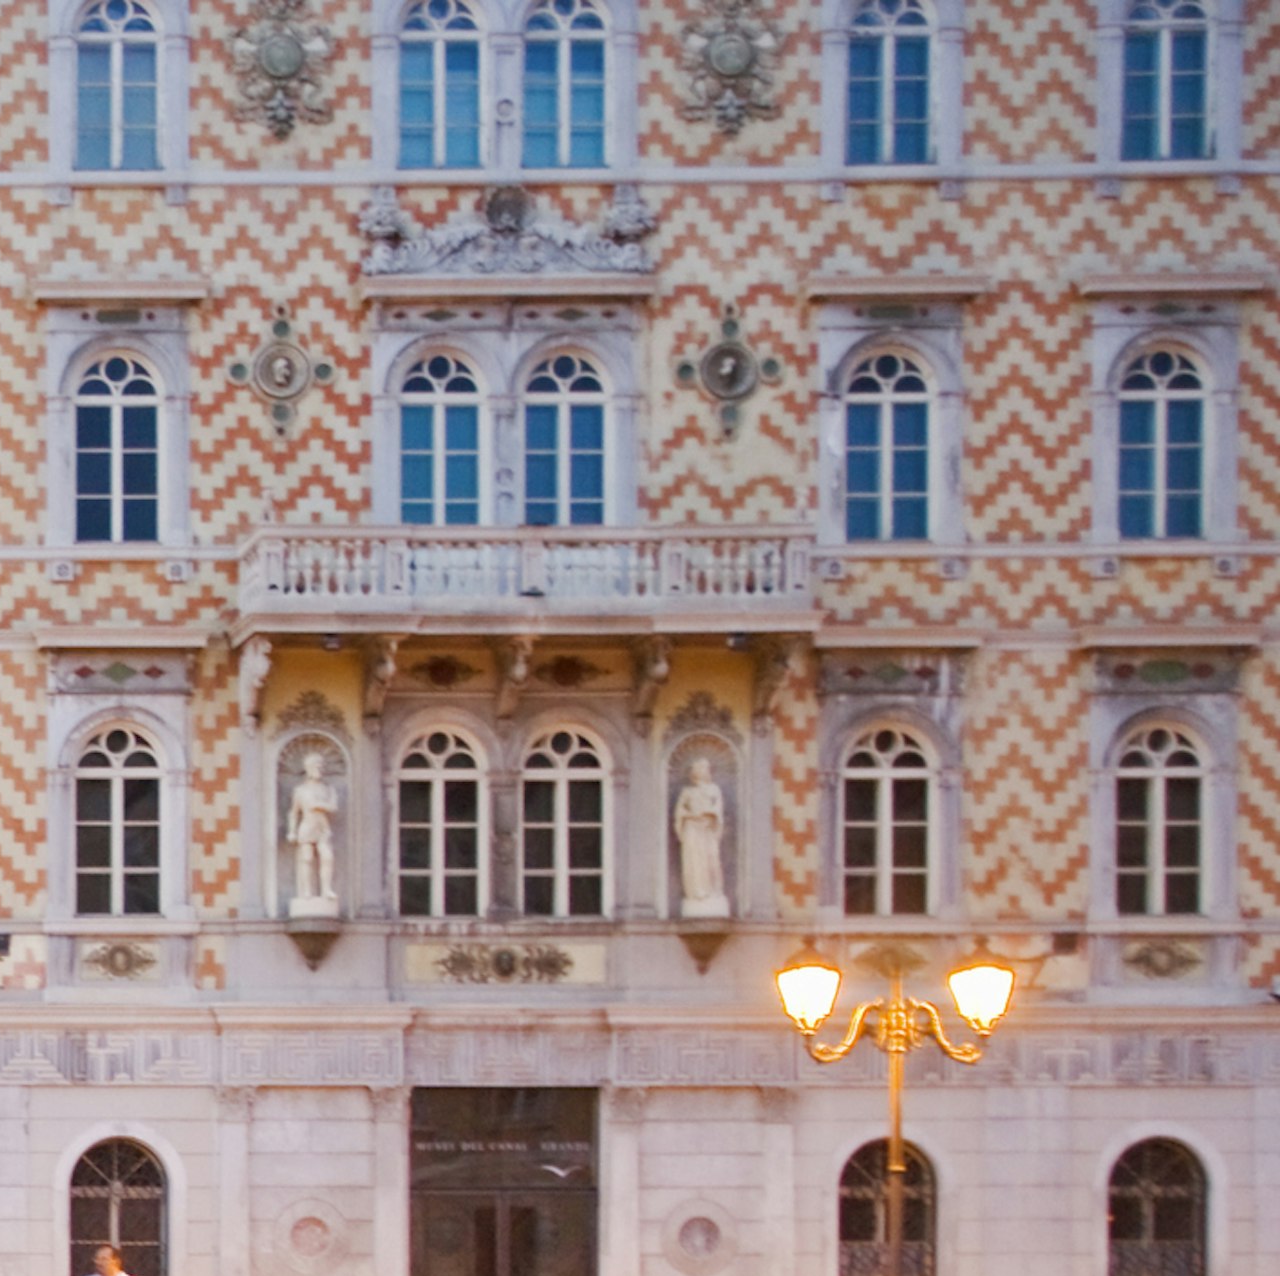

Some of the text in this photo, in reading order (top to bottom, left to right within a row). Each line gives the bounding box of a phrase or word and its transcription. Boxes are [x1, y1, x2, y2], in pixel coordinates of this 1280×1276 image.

[460, 1141, 485, 1152] DEL
[488, 1141, 528, 1152] CANAL
[540, 1141, 590, 1152] GRANDE
